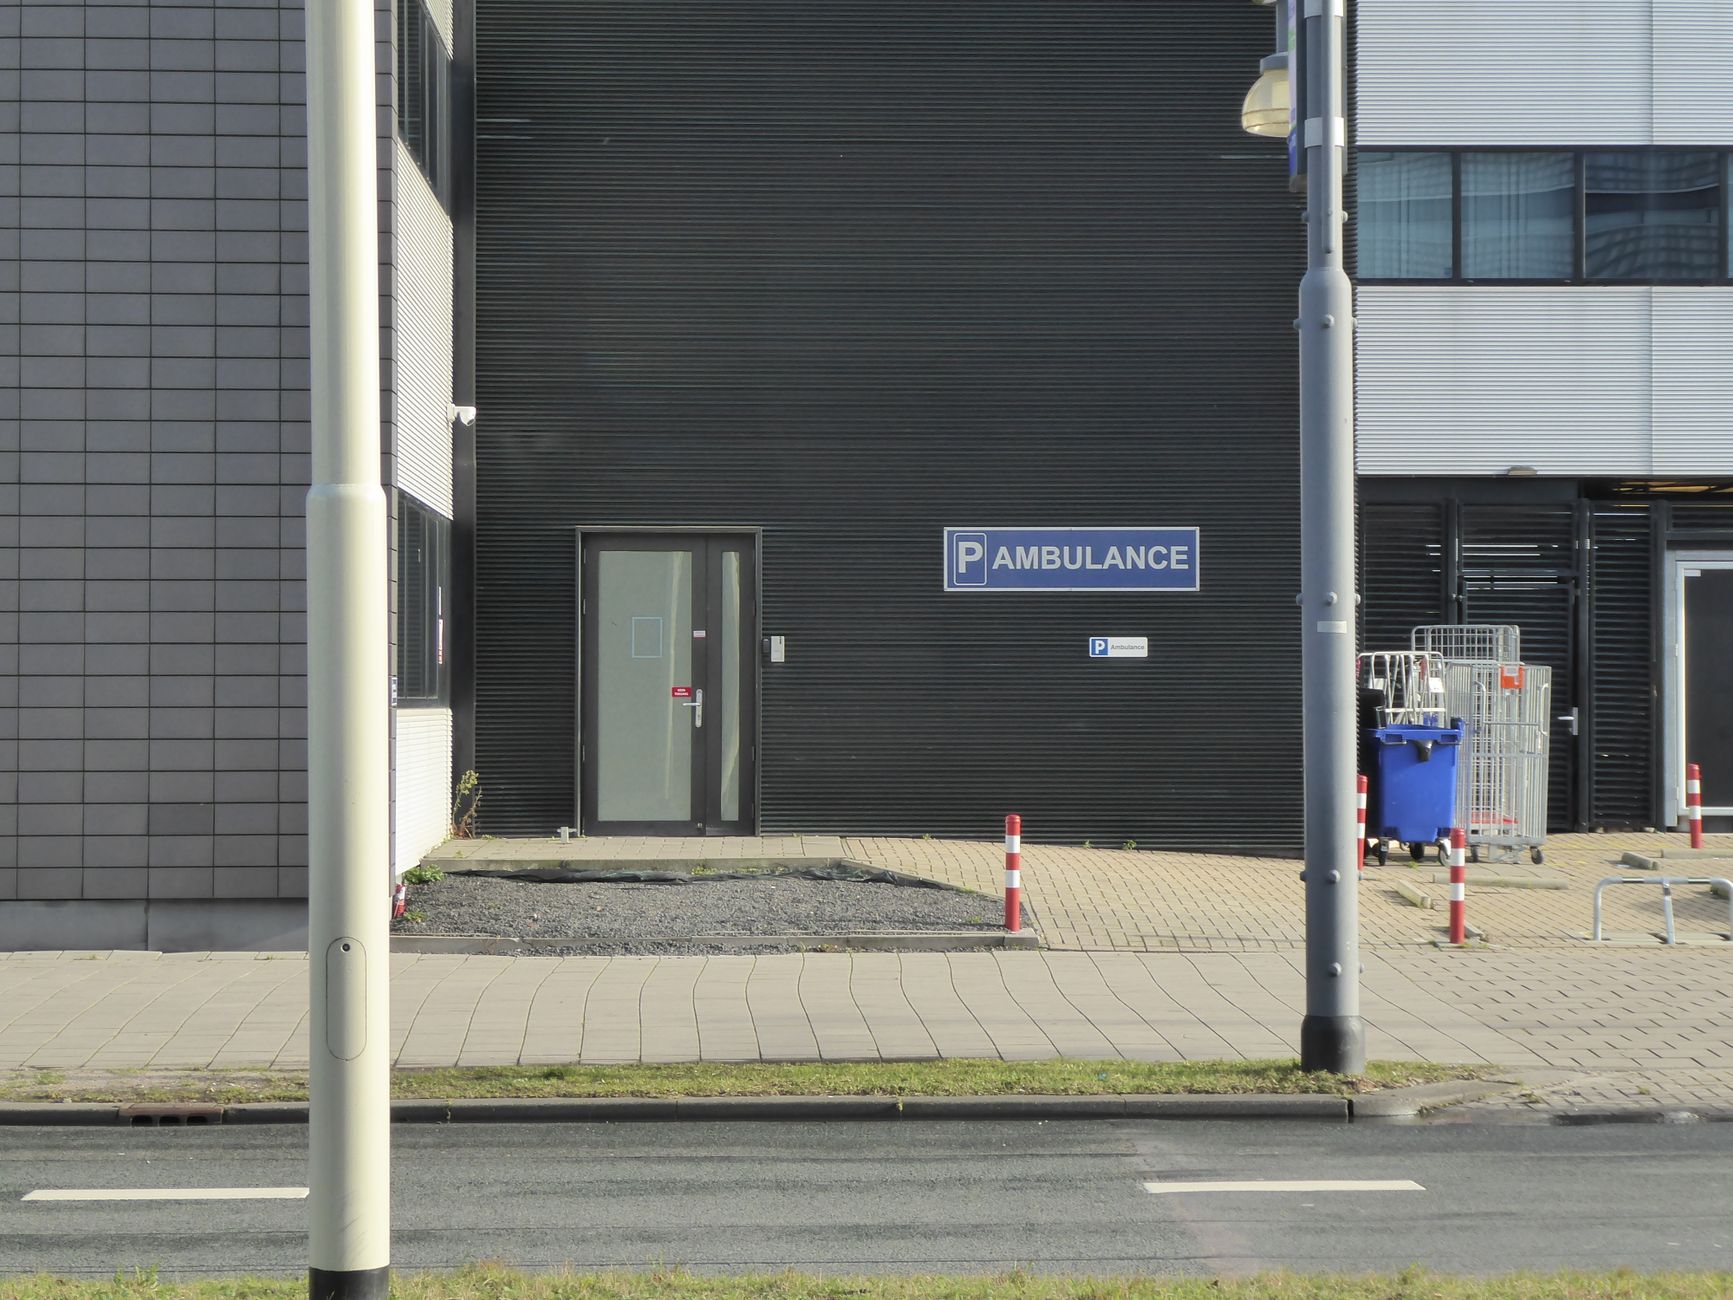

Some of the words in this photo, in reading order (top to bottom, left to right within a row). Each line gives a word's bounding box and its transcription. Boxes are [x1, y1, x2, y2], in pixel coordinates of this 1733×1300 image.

[958, 541, 984, 574] P
[992, 545, 1189, 570] AMBULANCE
[1095, 640, 1106, 655] P
